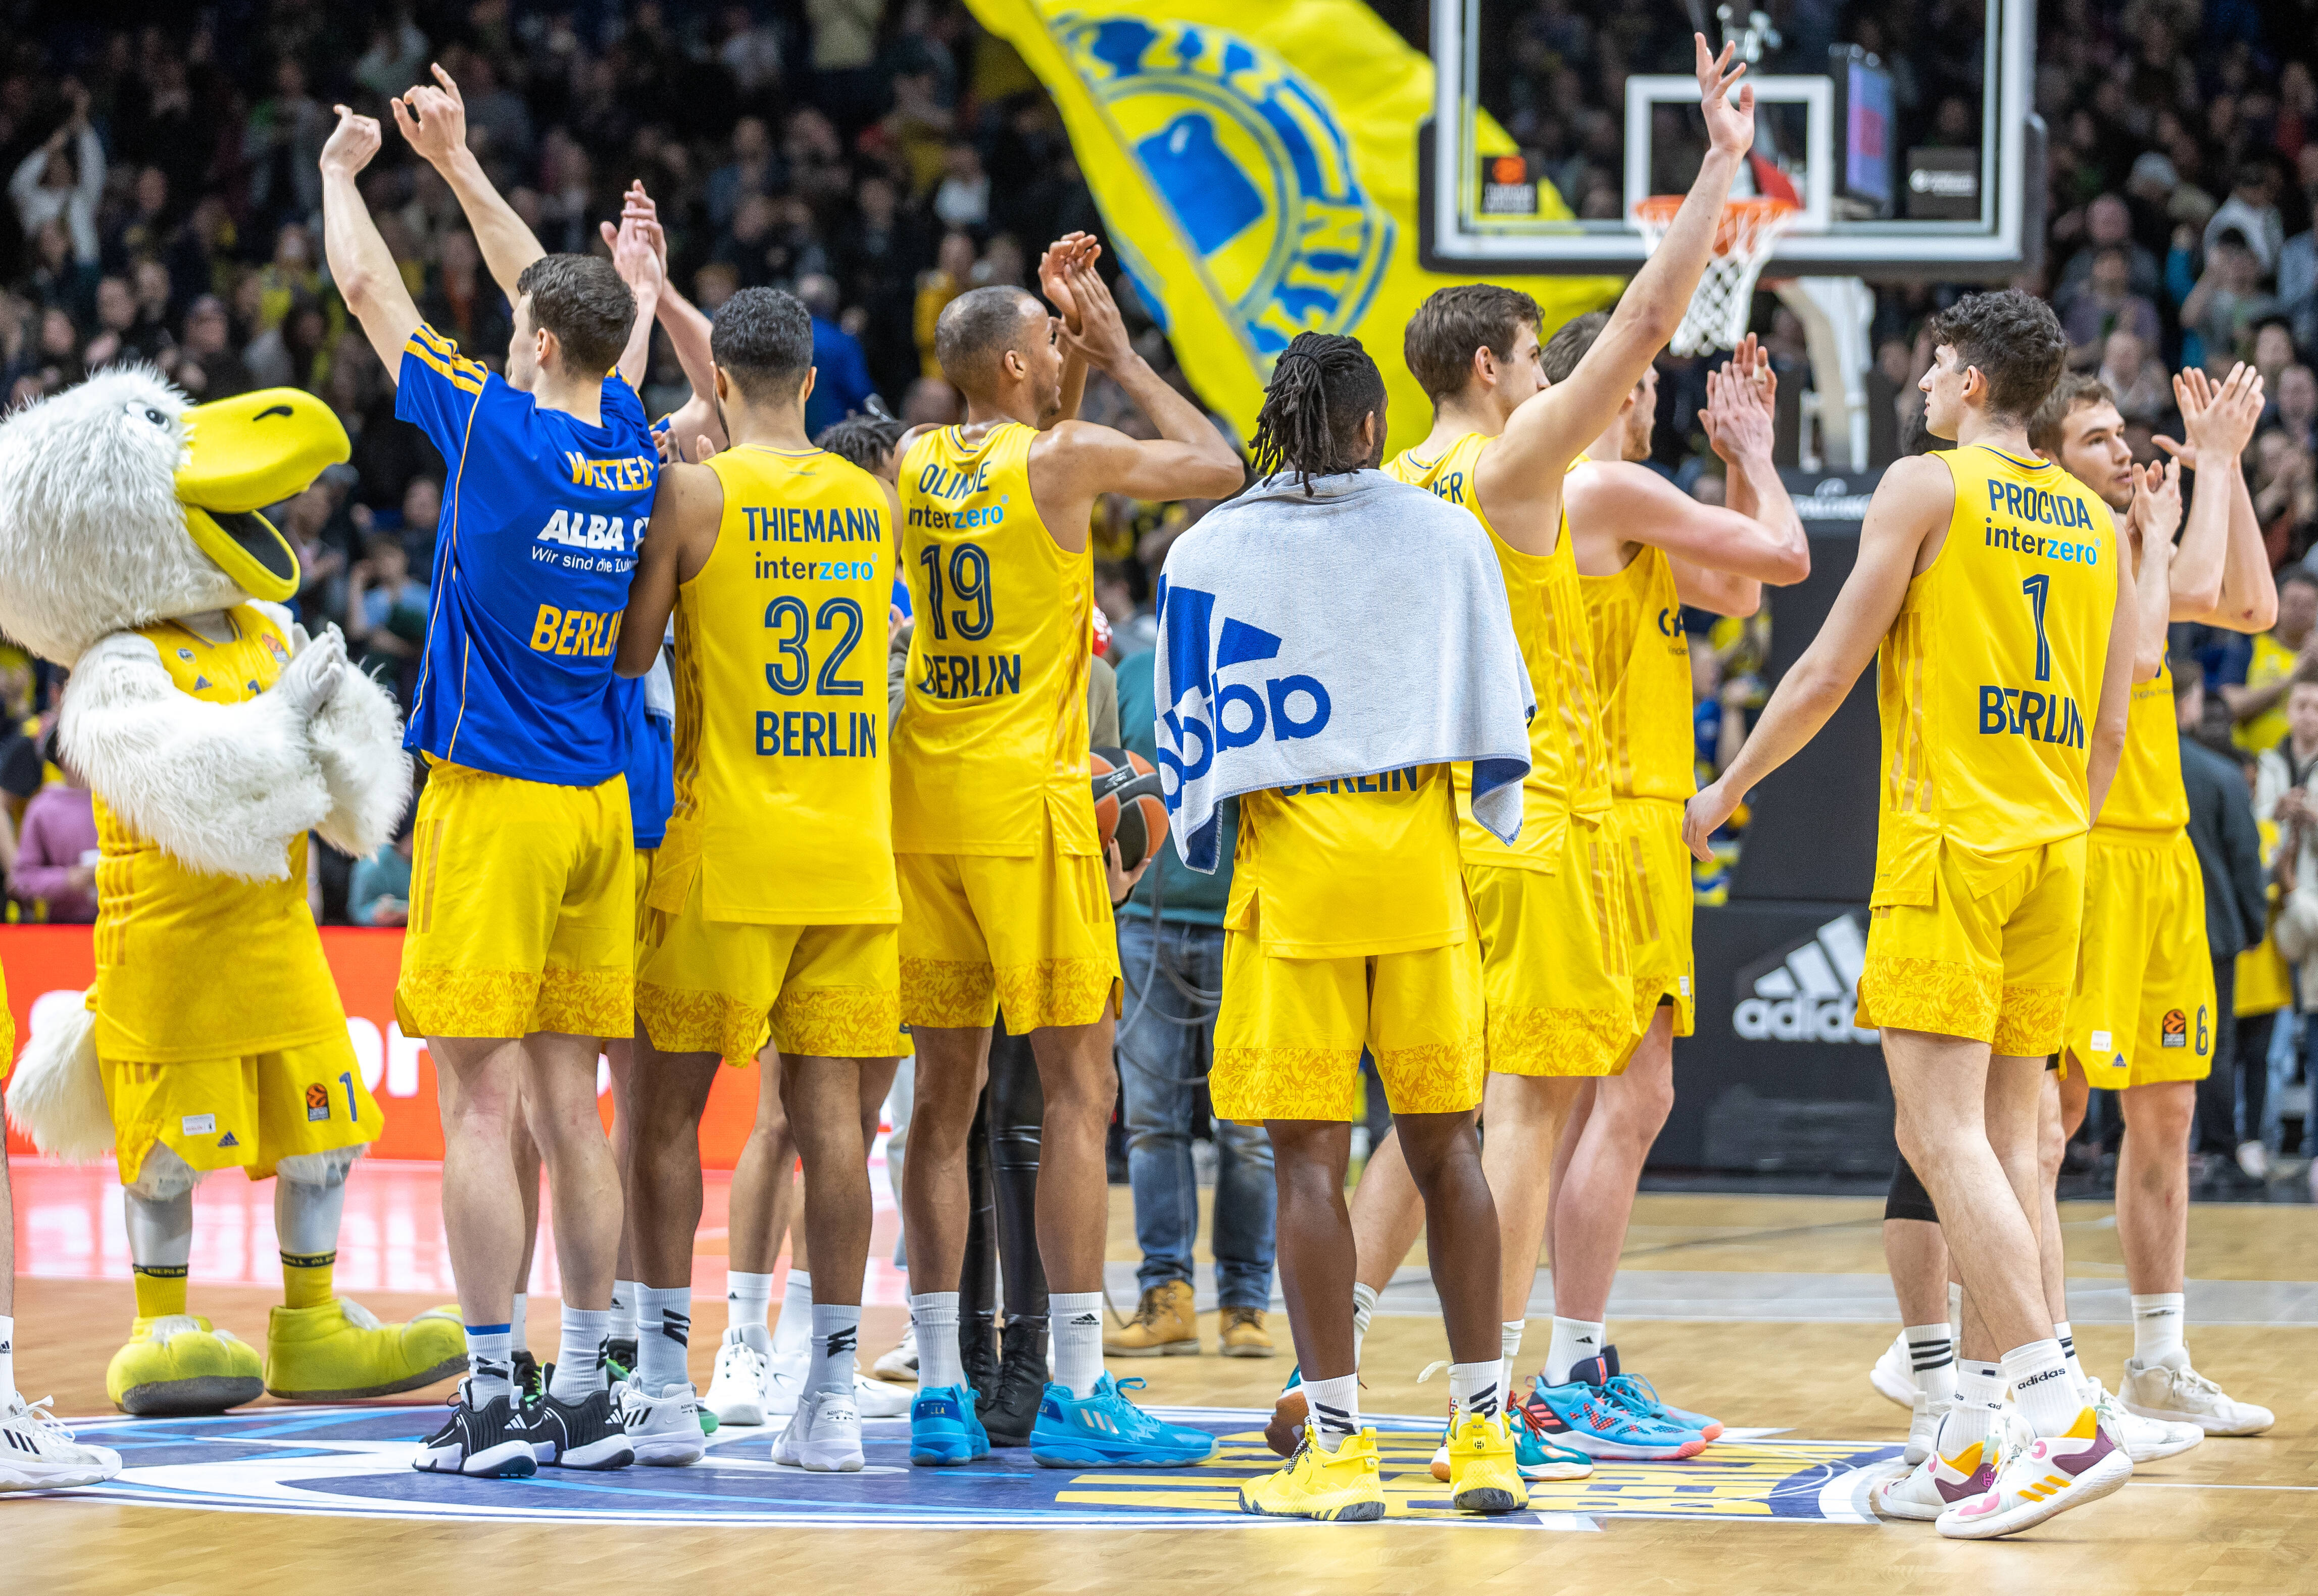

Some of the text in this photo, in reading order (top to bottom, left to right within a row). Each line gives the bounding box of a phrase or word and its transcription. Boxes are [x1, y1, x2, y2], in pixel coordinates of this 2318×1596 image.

[536, 509, 625, 552] ALBA
[742, 507, 880, 543] THIEMANN
[1987, 479, 2095, 531] PROCIDA
[532, 545, 559, 564] Wir
[562, 555, 594, 571] sind
[596, 558, 613, 573] die
[920, 542, 994, 641] 19
[764, 594, 864, 696] 32
[2023, 573, 2050, 681] 1
[916, 654, 1021, 700] BERLIN
[755, 711, 877, 758] BERLIN
[1979, 684, 2084, 750] BERLIN
[2195, 1004, 2208, 1056] 6
[338, 1071, 358, 1122] 1
[2017, 1368, 2066, 1390] adidas
